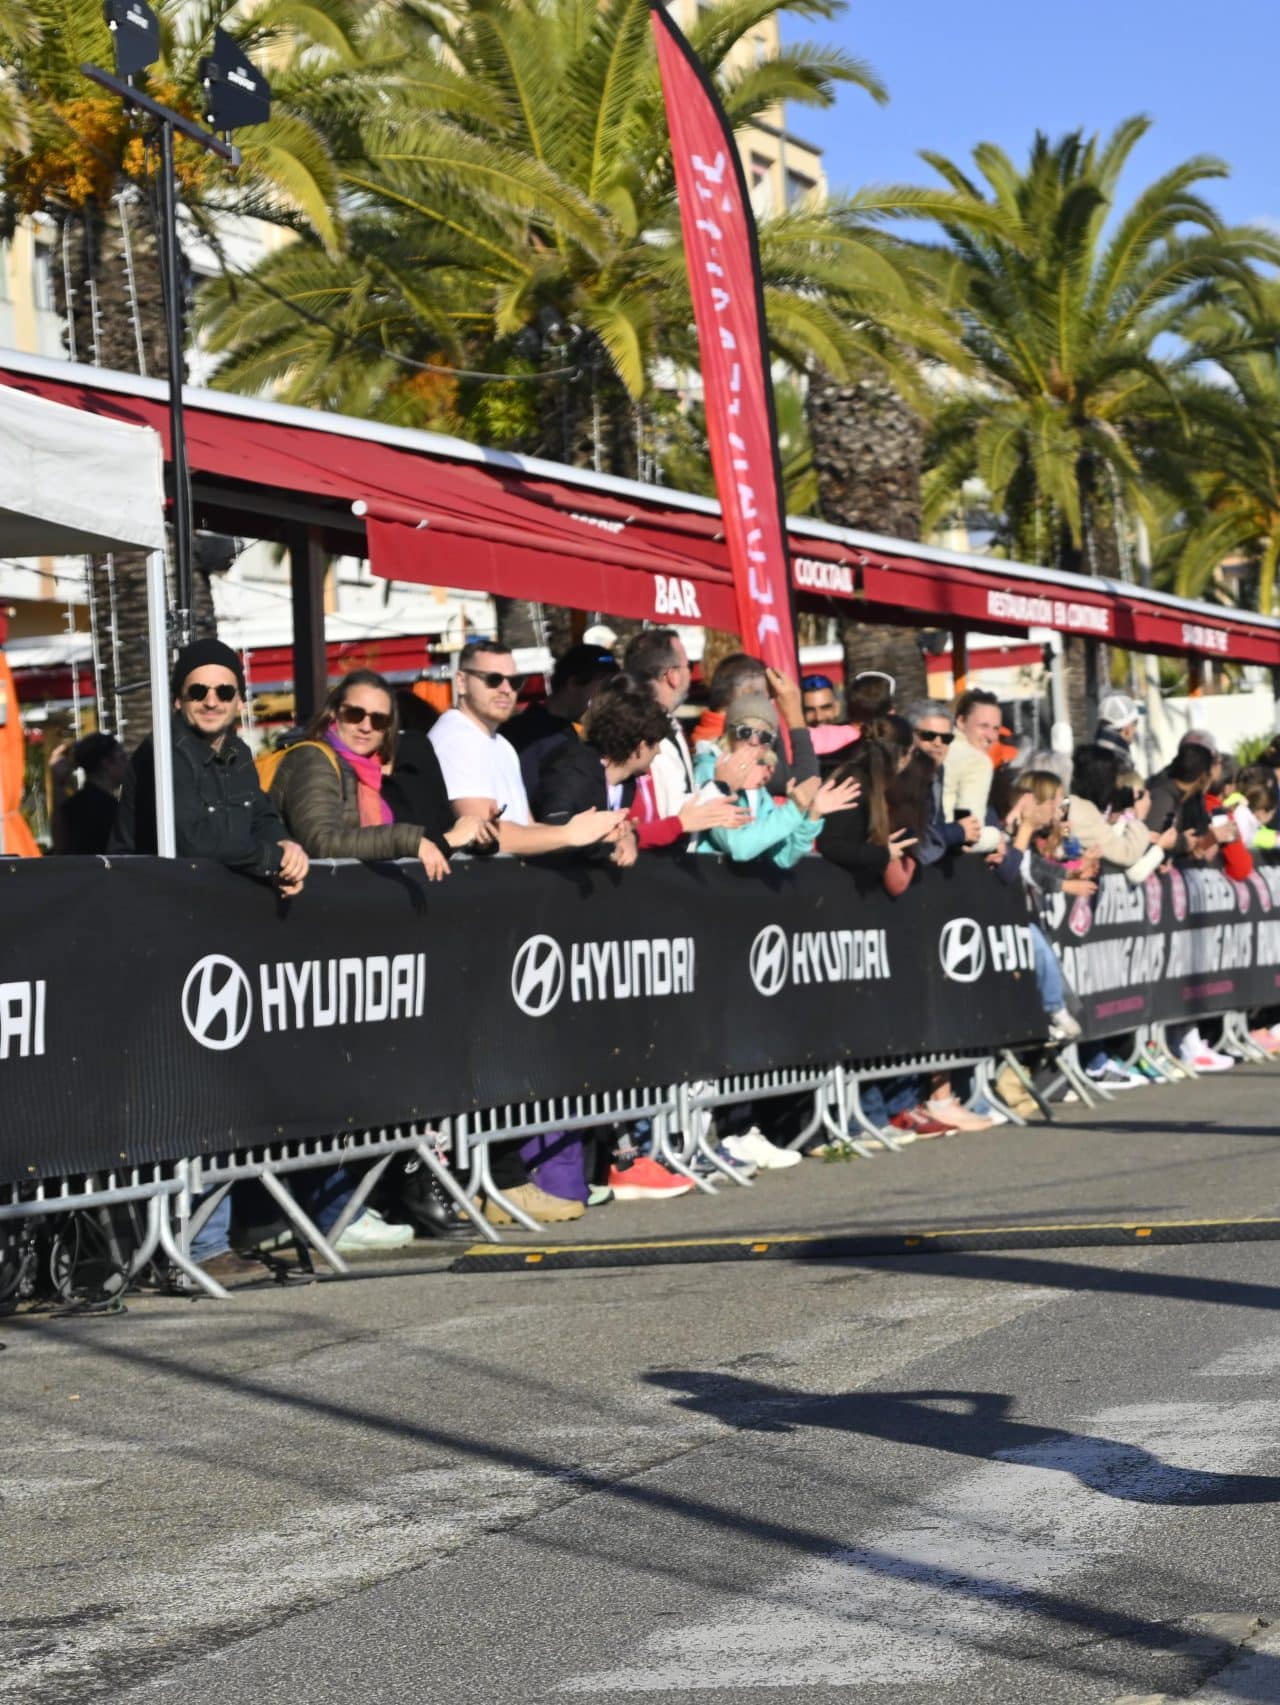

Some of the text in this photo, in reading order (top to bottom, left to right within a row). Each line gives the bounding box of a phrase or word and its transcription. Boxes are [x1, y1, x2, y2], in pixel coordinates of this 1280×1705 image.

[654, 574, 702, 619] BAR
[570, 937, 695, 1002] HYUNDAI
[793, 929, 891, 985] HYUNDAI
[259, 953, 426, 1032] HYUNDAI
